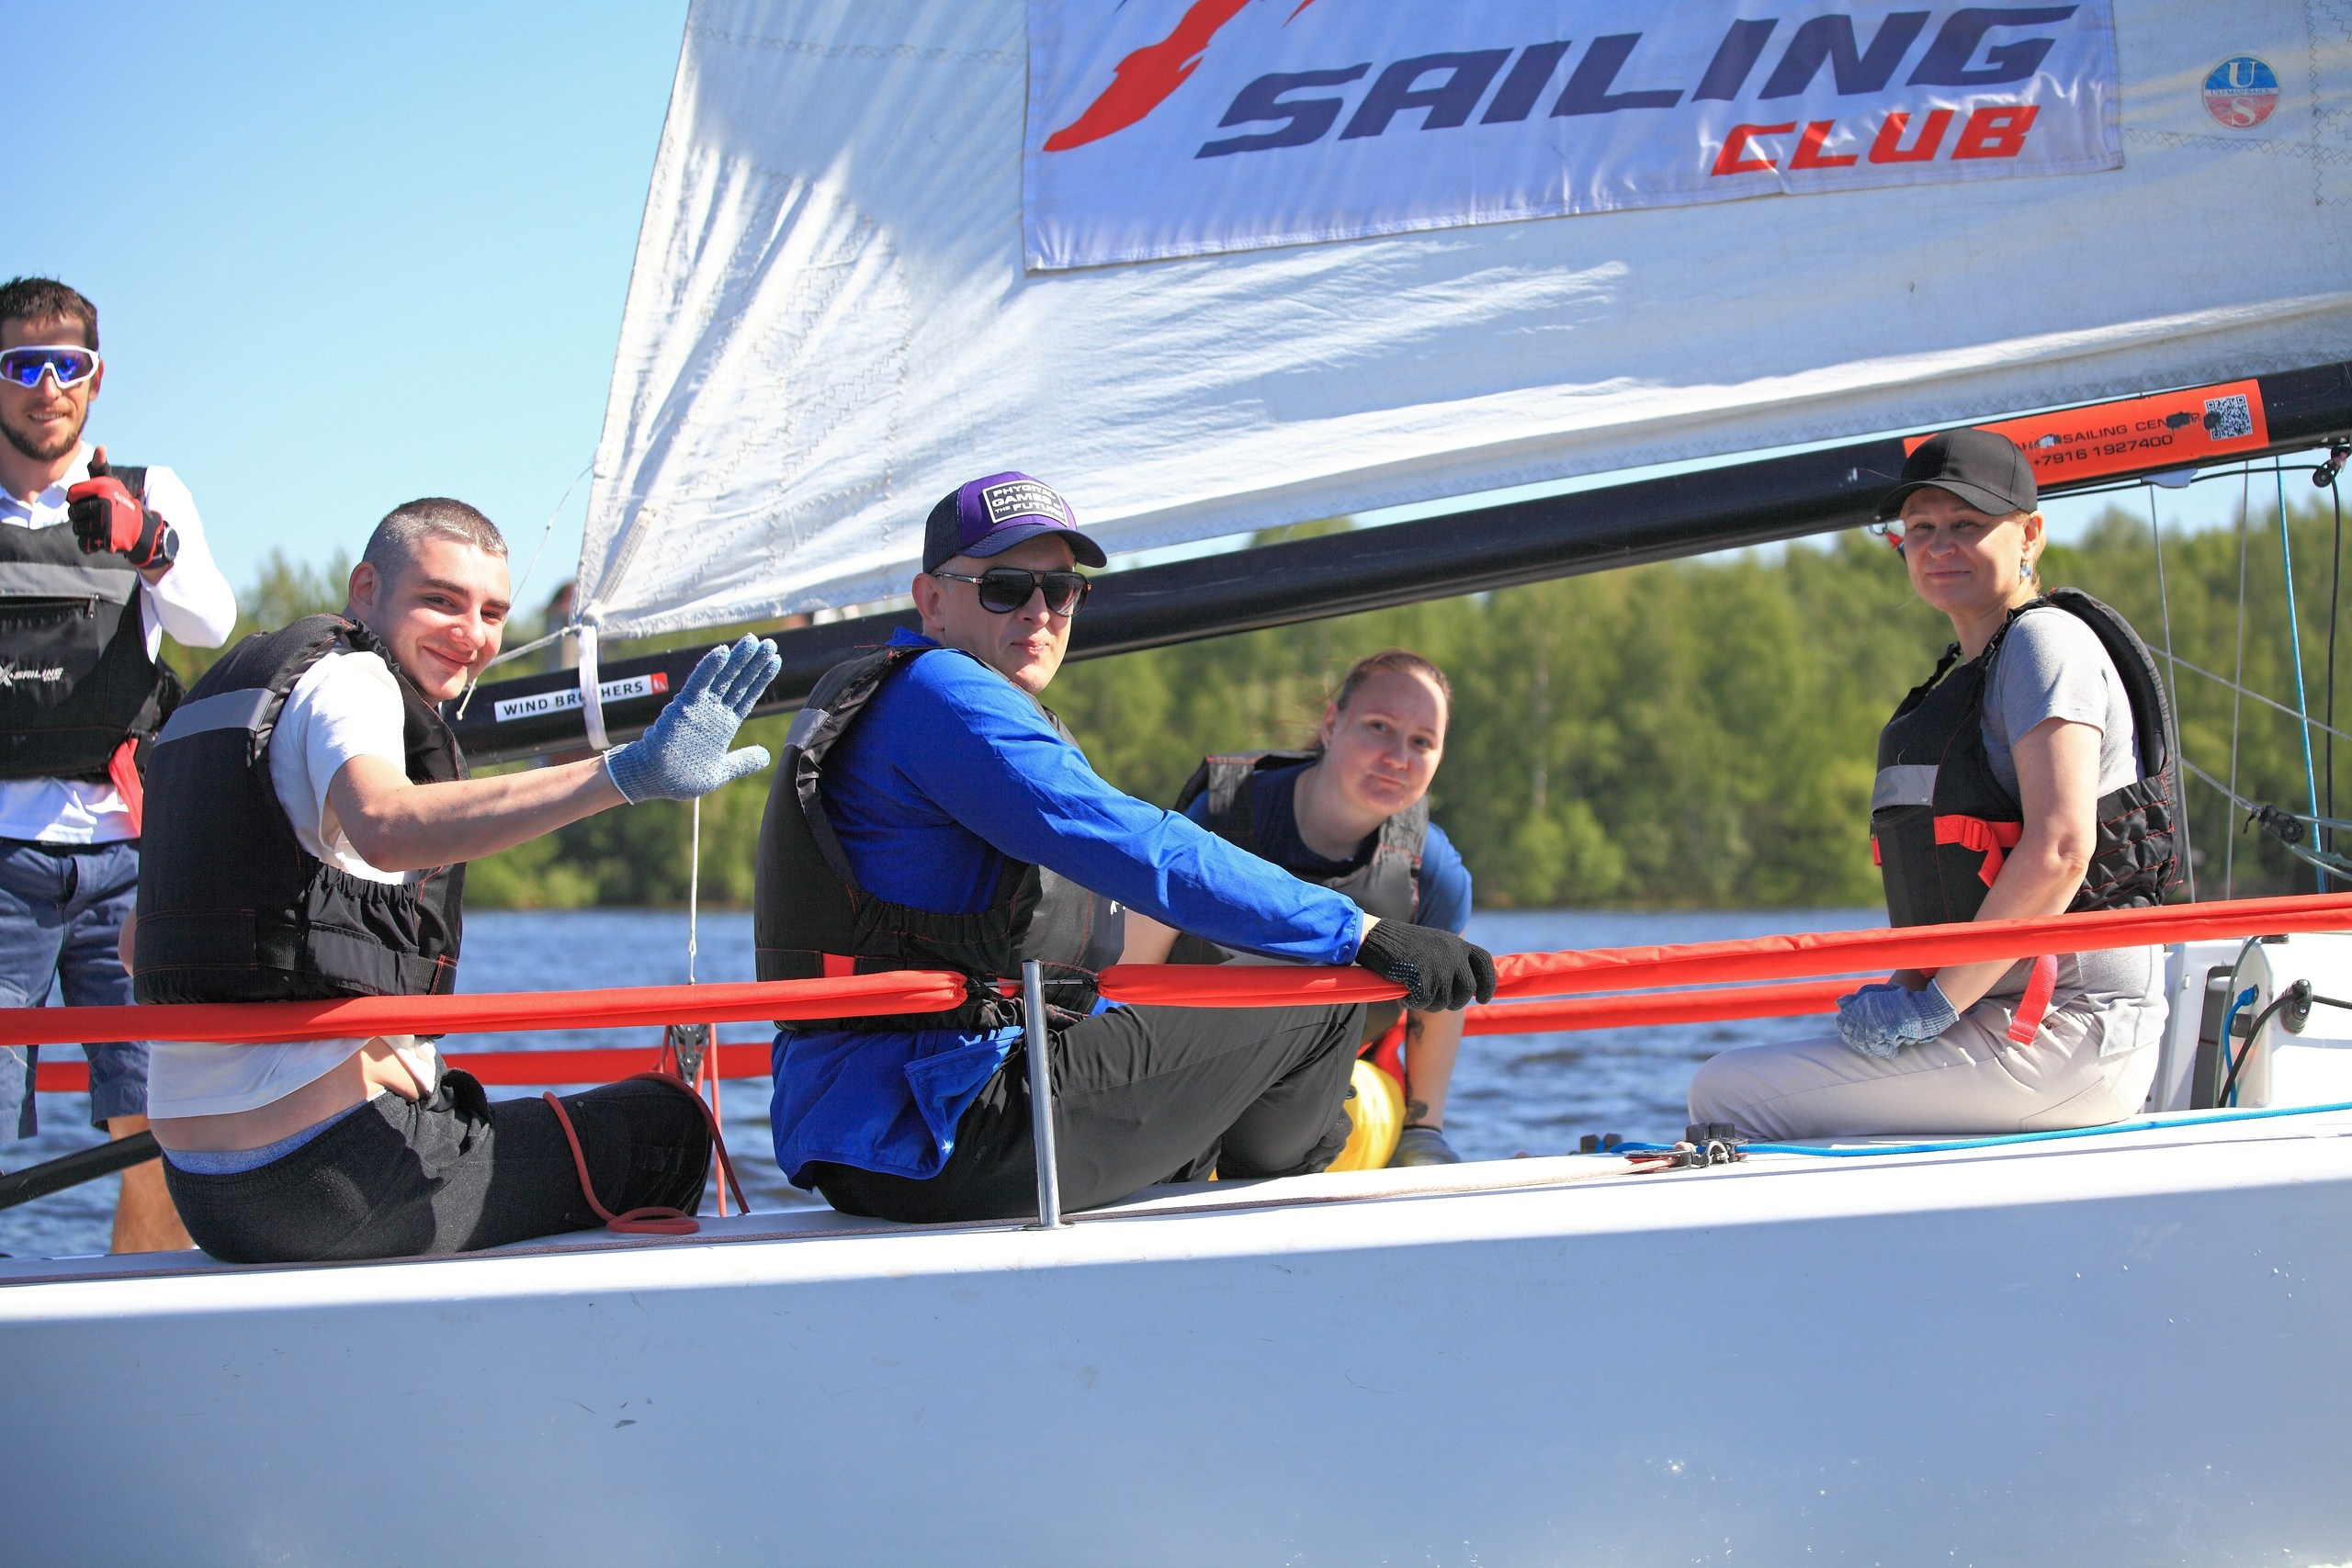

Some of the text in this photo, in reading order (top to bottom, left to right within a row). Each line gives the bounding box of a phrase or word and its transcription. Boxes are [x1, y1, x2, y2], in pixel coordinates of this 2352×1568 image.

[1194, 4, 2079, 159] SAILING
[2228, 61, 2257, 88] U
[2231, 96, 2256, 127] S
[1711, 105, 2041, 176] CLUB
[2063, 424, 2128, 444] SAILING
[2135, 412, 2201, 432] CENR
[2093, 434, 2174, 457] 1927400
[994, 505, 1011, 513] THE
[503, 681, 643, 716] WIND BRHERS
